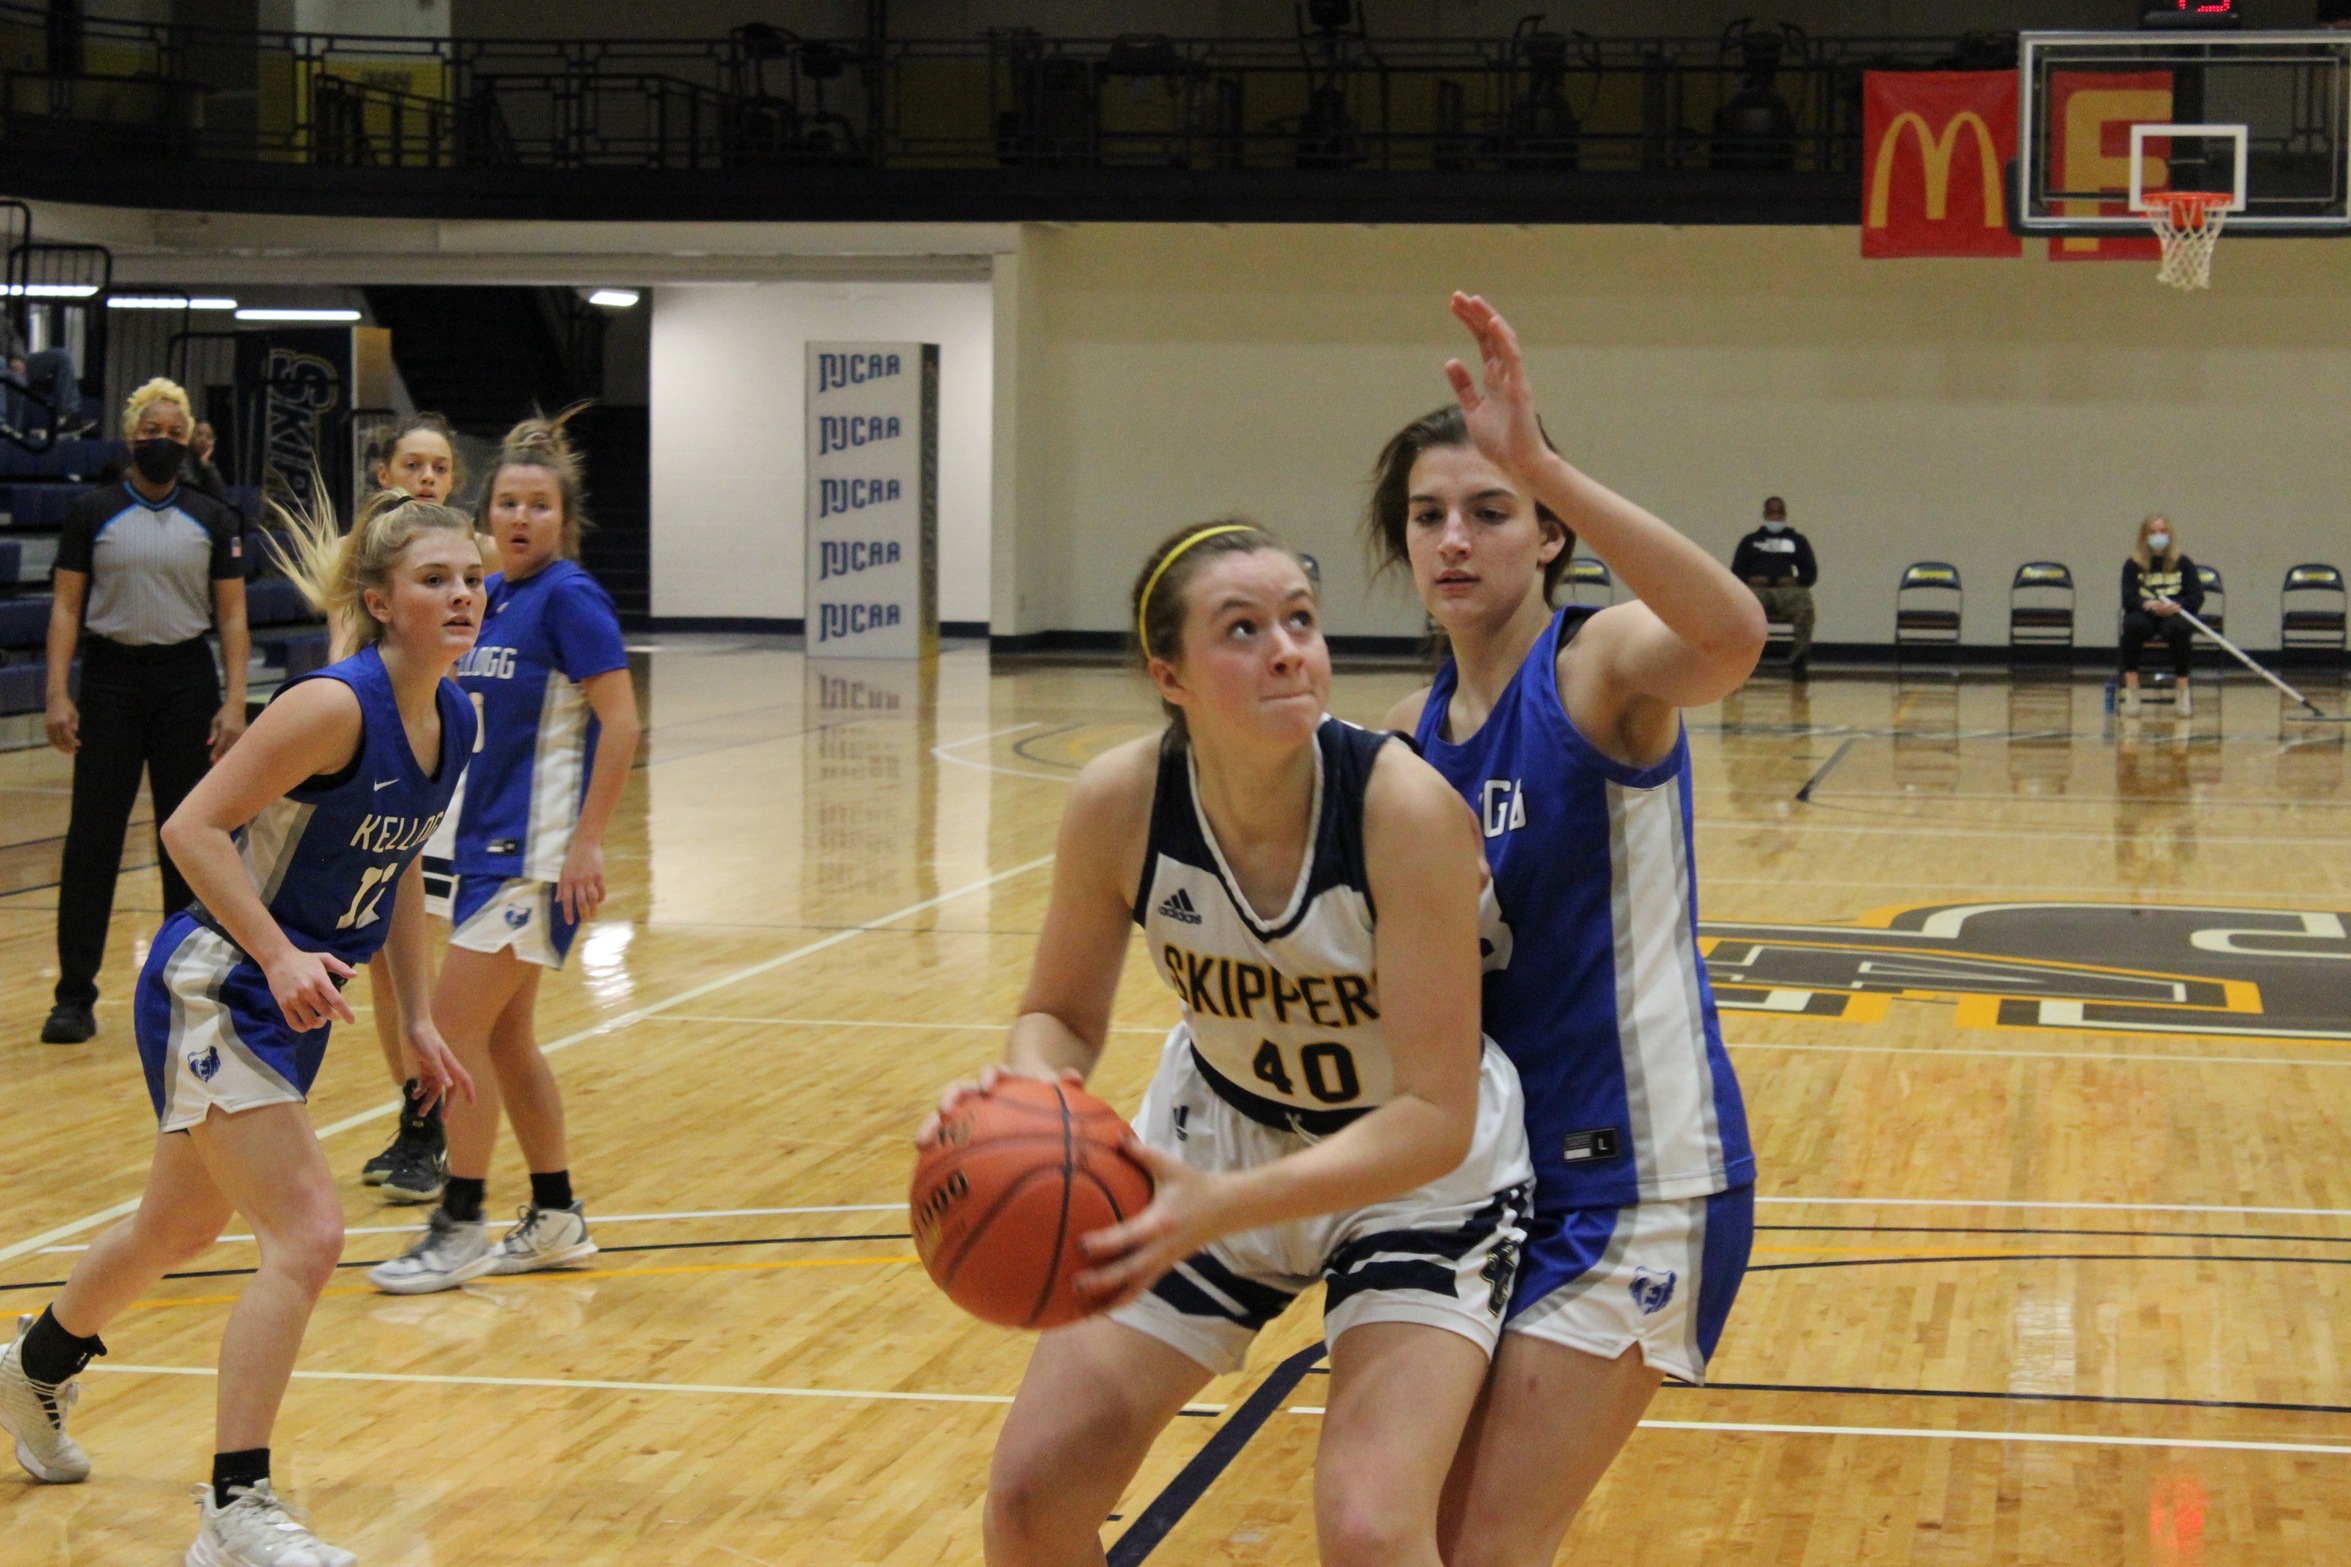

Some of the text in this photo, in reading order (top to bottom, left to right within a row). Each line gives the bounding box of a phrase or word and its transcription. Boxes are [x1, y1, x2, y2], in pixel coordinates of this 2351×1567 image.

[819, 354, 901, 393] NJCAA
[819, 416, 901, 456] NJCAA
[819, 479, 901, 518] NJCAA
[819, 541, 901, 581] NJCAA
[819, 604, 901, 643] NJCAA
[1252, 1037, 1362, 1105] 40
